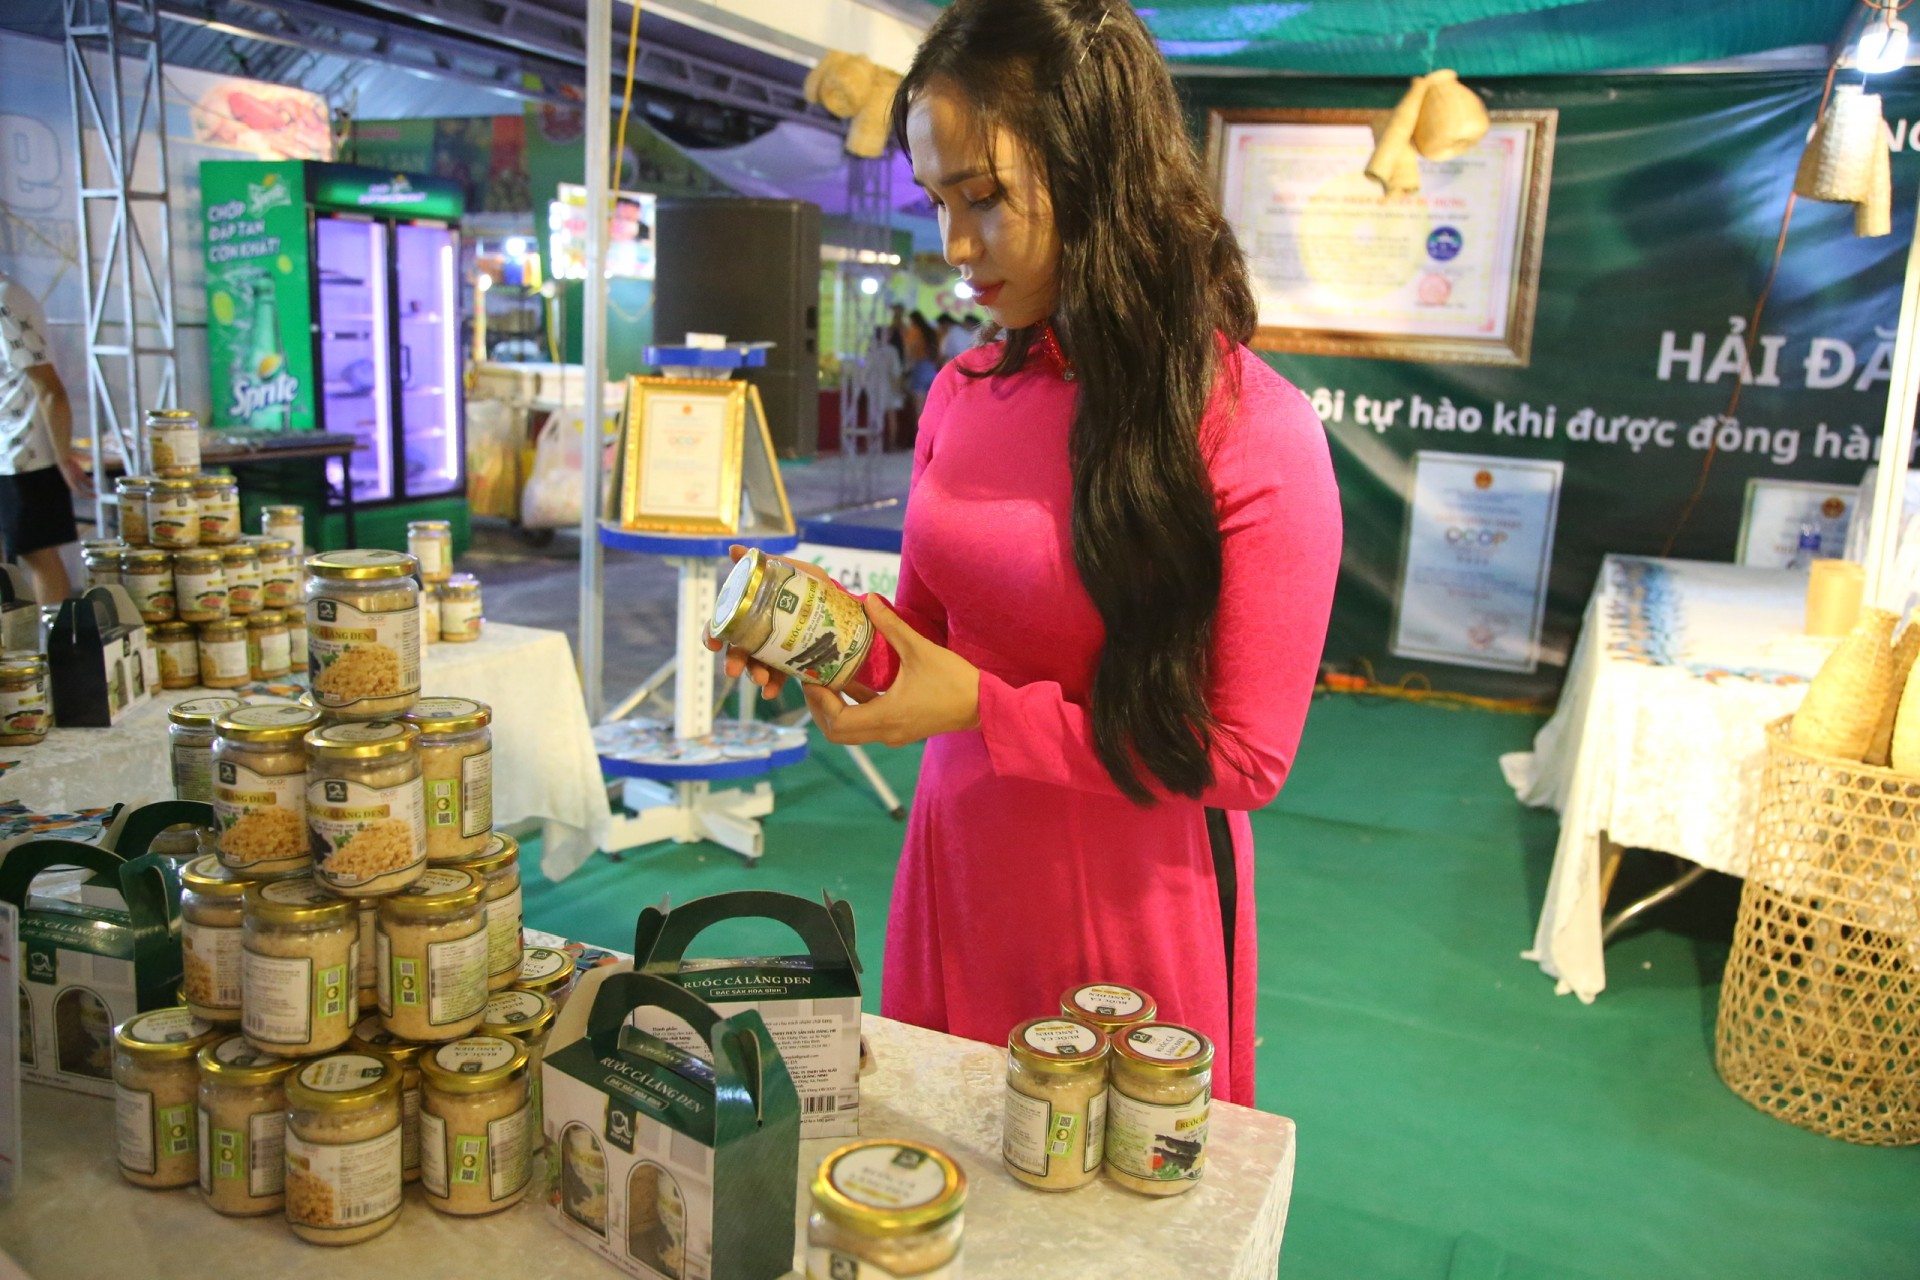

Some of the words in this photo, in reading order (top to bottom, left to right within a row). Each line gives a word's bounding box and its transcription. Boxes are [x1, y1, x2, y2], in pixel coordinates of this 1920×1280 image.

[237, 219, 265, 237] TAN
[1657, 315, 1787, 387] HẢI
[1804, 325, 1899, 391] ĐĂ
[229, 372, 299, 418] Sprite
[1354, 394, 1403, 433] tự
[1410, 394, 1482, 432] hào
[1493, 400, 1556, 439] khi
[1566, 407, 1676, 452] được
[1687, 412, 1800, 465] đồng
[683, 977, 722, 989] RUỐC
[724, 975, 742, 986] CÁ
[745, 975, 781, 985] LĂNG
[784, 976, 811, 985] ĐEN
[600, 1056, 634, 1076] RUỐC
[630, 1070, 650, 1085] CÁ
[645, 1077, 679, 1099] LĂNG
[676, 1093, 705, 1113] ĐEN
